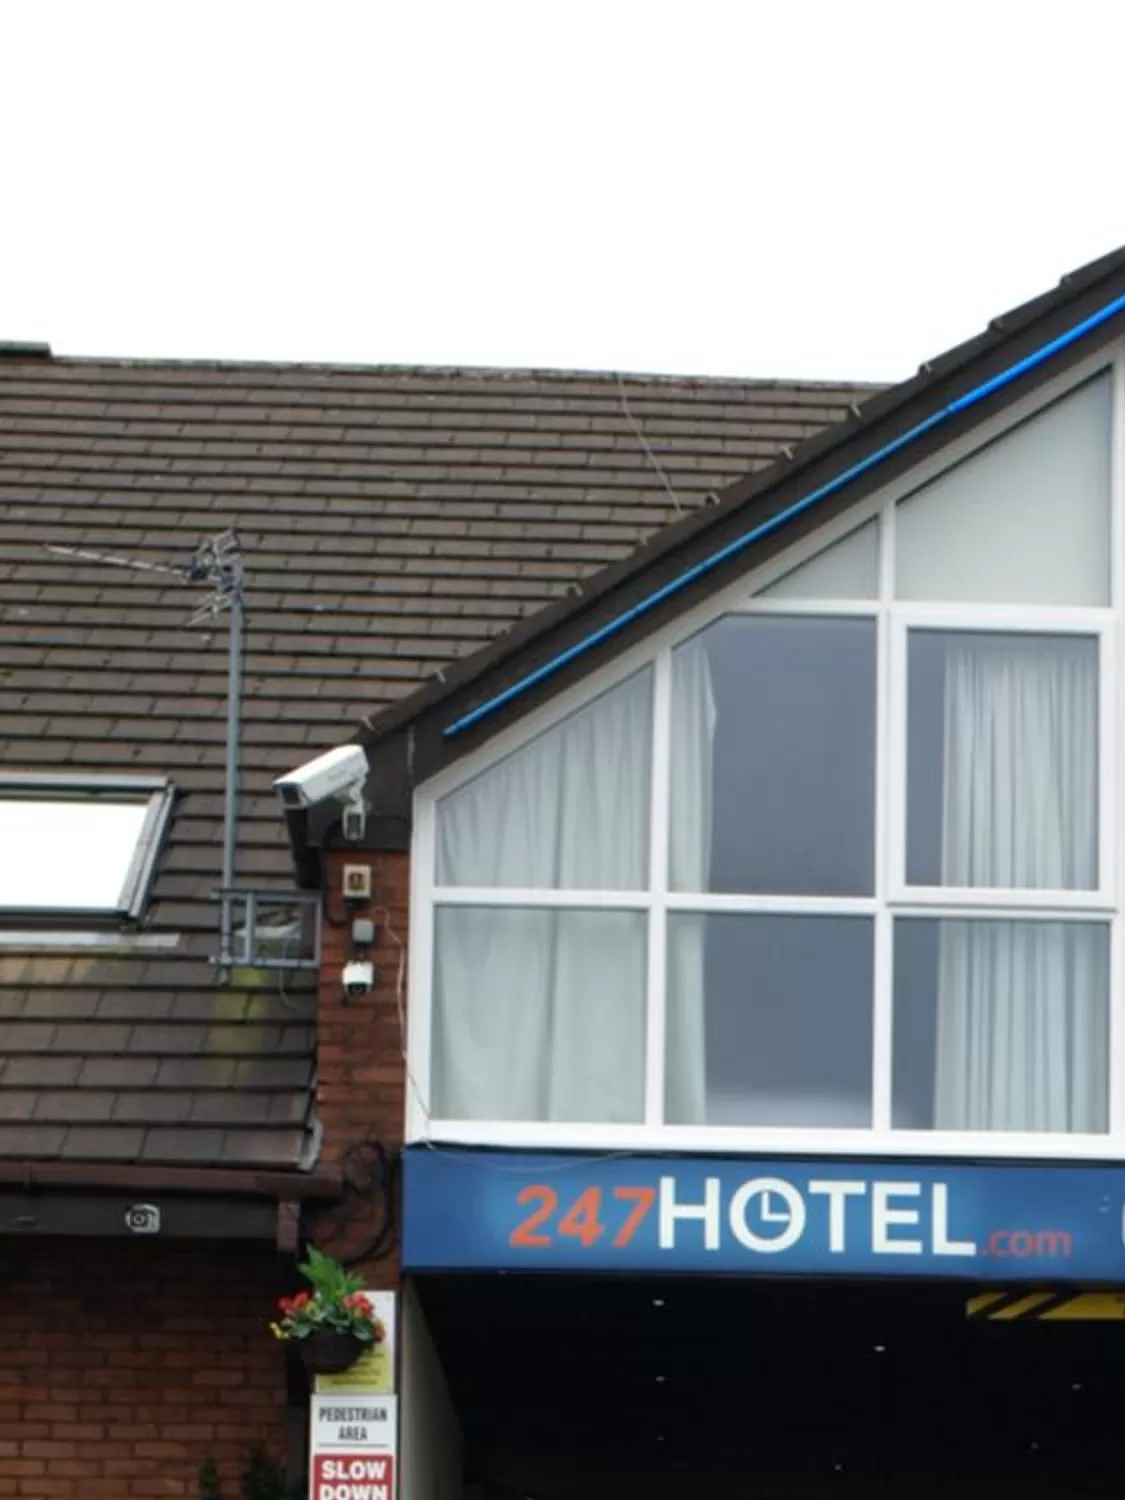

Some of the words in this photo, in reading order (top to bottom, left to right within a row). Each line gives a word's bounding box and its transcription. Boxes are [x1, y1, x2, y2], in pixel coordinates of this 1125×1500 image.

[318, 1406, 387, 1421] PEDESTRIAN
[337, 1426, 368, 1441] AREA
[321, 1460, 386, 1480] SLOW
